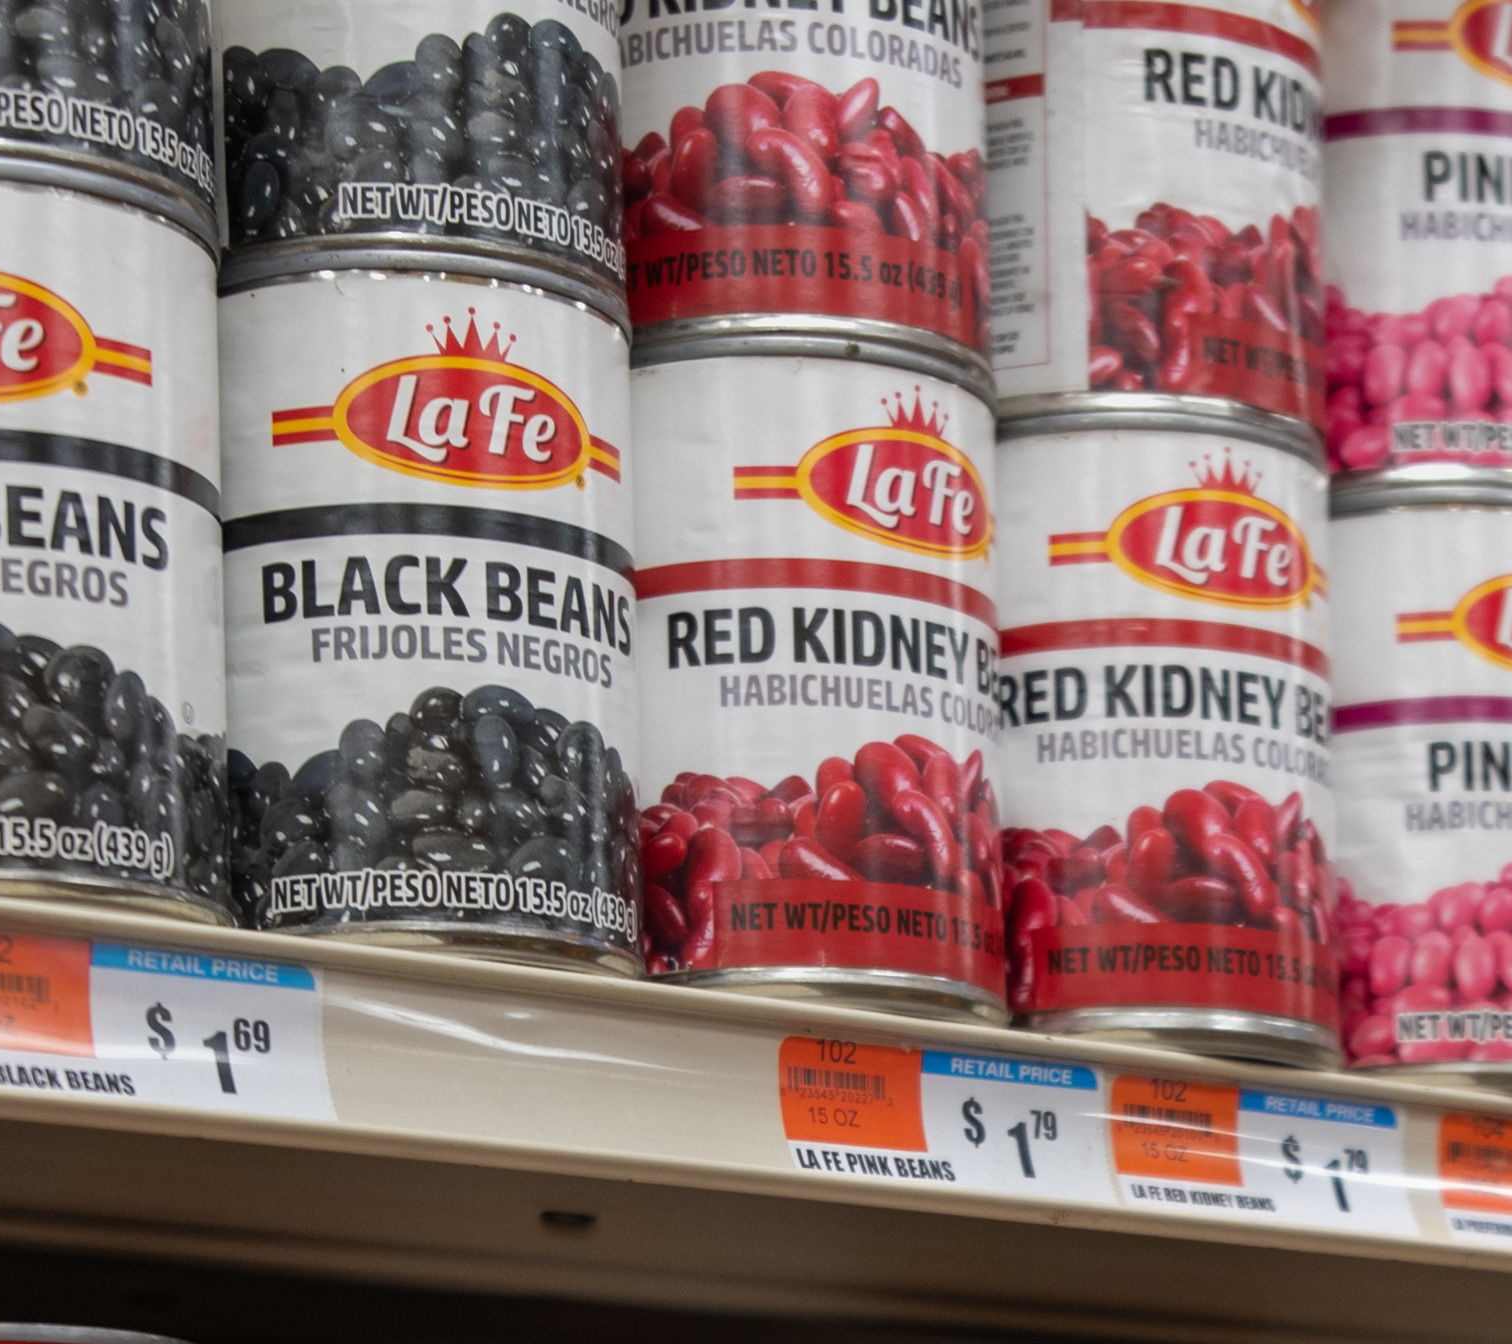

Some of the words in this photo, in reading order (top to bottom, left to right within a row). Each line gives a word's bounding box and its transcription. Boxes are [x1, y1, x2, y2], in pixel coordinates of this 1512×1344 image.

[1144, 48, 1241, 111] RED
[70, 97, 136, 148] NETO
[752, 249, 817, 279] NETO
[262, 554, 468, 627] BLACK
[485, 568, 634, 661] BEANS
[311, 623, 488, 664] FRIJOLES
[496, 630, 614, 692] NEGROS
[667, 606, 777, 671] RED
[793, 606, 969, 680] KIDNEY
[719, 673, 934, 719] HABICHUELAS
[1036, 729, 1246, 766] HABICHUELAS
[730, 901, 778, 932] NET
[783, 900, 890, 941] WT/PESO
[896, 908, 949, 942] NETO
[126, 948, 206, 977] RETAIL
[211, 959, 279, 984] PRICE
[146, 1000, 177, 1061] $
[816, 1038, 858, 1066] 102
[950, 1057, 1015, 1081] RETAIL
[1018, 1064, 1073, 1086] PRICE
[69, 1069, 137, 1097] BEANS
[807, 1106, 831, 1127] 15
[835, 1110, 861, 1129] OZ
[961, 1096, 987, 1149] $
[795, 1146, 823, 1171] LA
[825, 1149, 846, 1172] FE
[848, 1152, 891, 1178] PINK
[895, 1156, 956, 1183] BEANS
